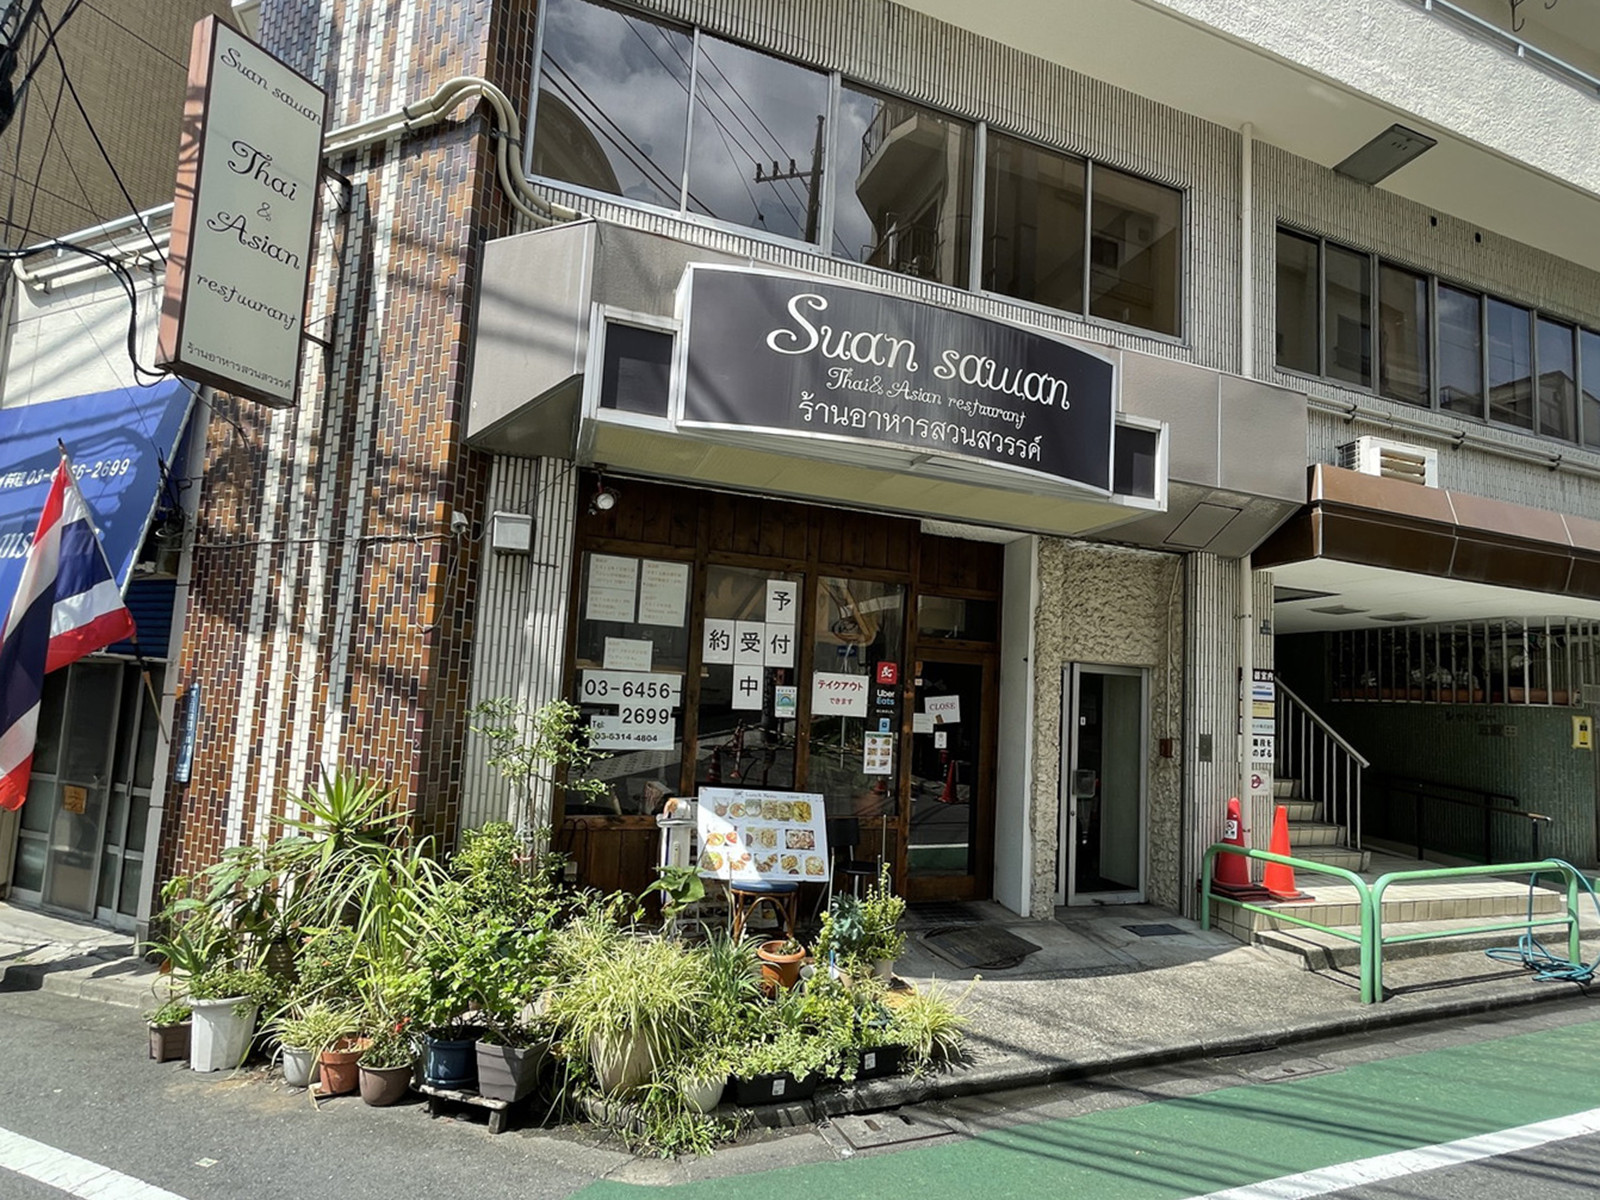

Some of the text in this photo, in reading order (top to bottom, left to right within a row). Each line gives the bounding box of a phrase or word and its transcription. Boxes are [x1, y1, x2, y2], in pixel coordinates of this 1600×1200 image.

[220, 47, 322, 127] Suan sawan
[227, 140, 298, 201] Thai
[256, 201, 272, 222] &
[206, 210, 301, 270] Asian
[766, 293, 1071, 411] Suan sawan
[886, 383, 942, 406] Asian
[798, 391, 1044, 463] ร้านอาหารสวนสวรรค์
[27, 458, 131, 486] 03-656-2699
[772, 591, 792, 611] 予
[585, 679, 681, 699] 03-6456-
[739, 675, 759, 698] 中
[817, 679, 863, 691] テイクアウト
[876, 689, 895, 698] Uber
[829, 697, 853, 705] できます
[876, 697, 895, 705] Eats
[929, 702, 957, 711] CLOSE
[622, 707, 669, 725] 2699
